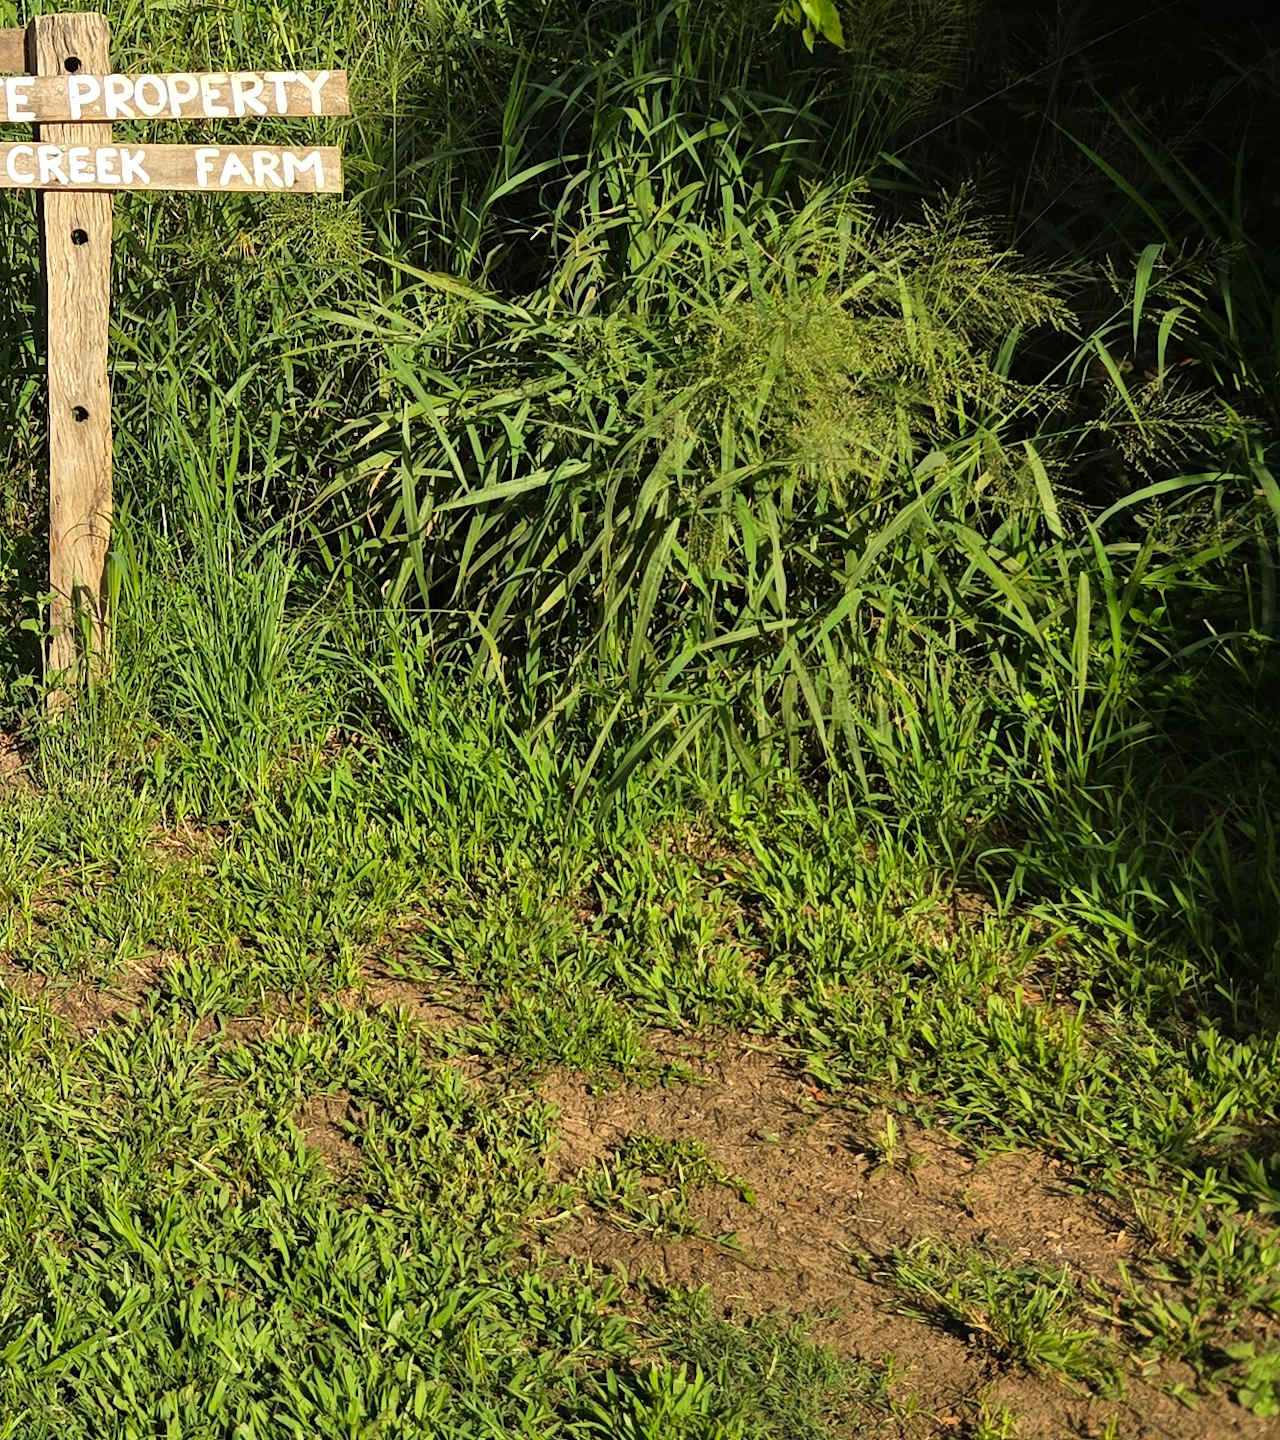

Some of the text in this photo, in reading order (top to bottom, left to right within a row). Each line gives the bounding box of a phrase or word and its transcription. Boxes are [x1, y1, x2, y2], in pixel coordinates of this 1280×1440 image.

[68, 71, 329, 120] PROPERTY
[7, 145, 151, 186] CREEK
[195, 148, 325, 188] FARM
